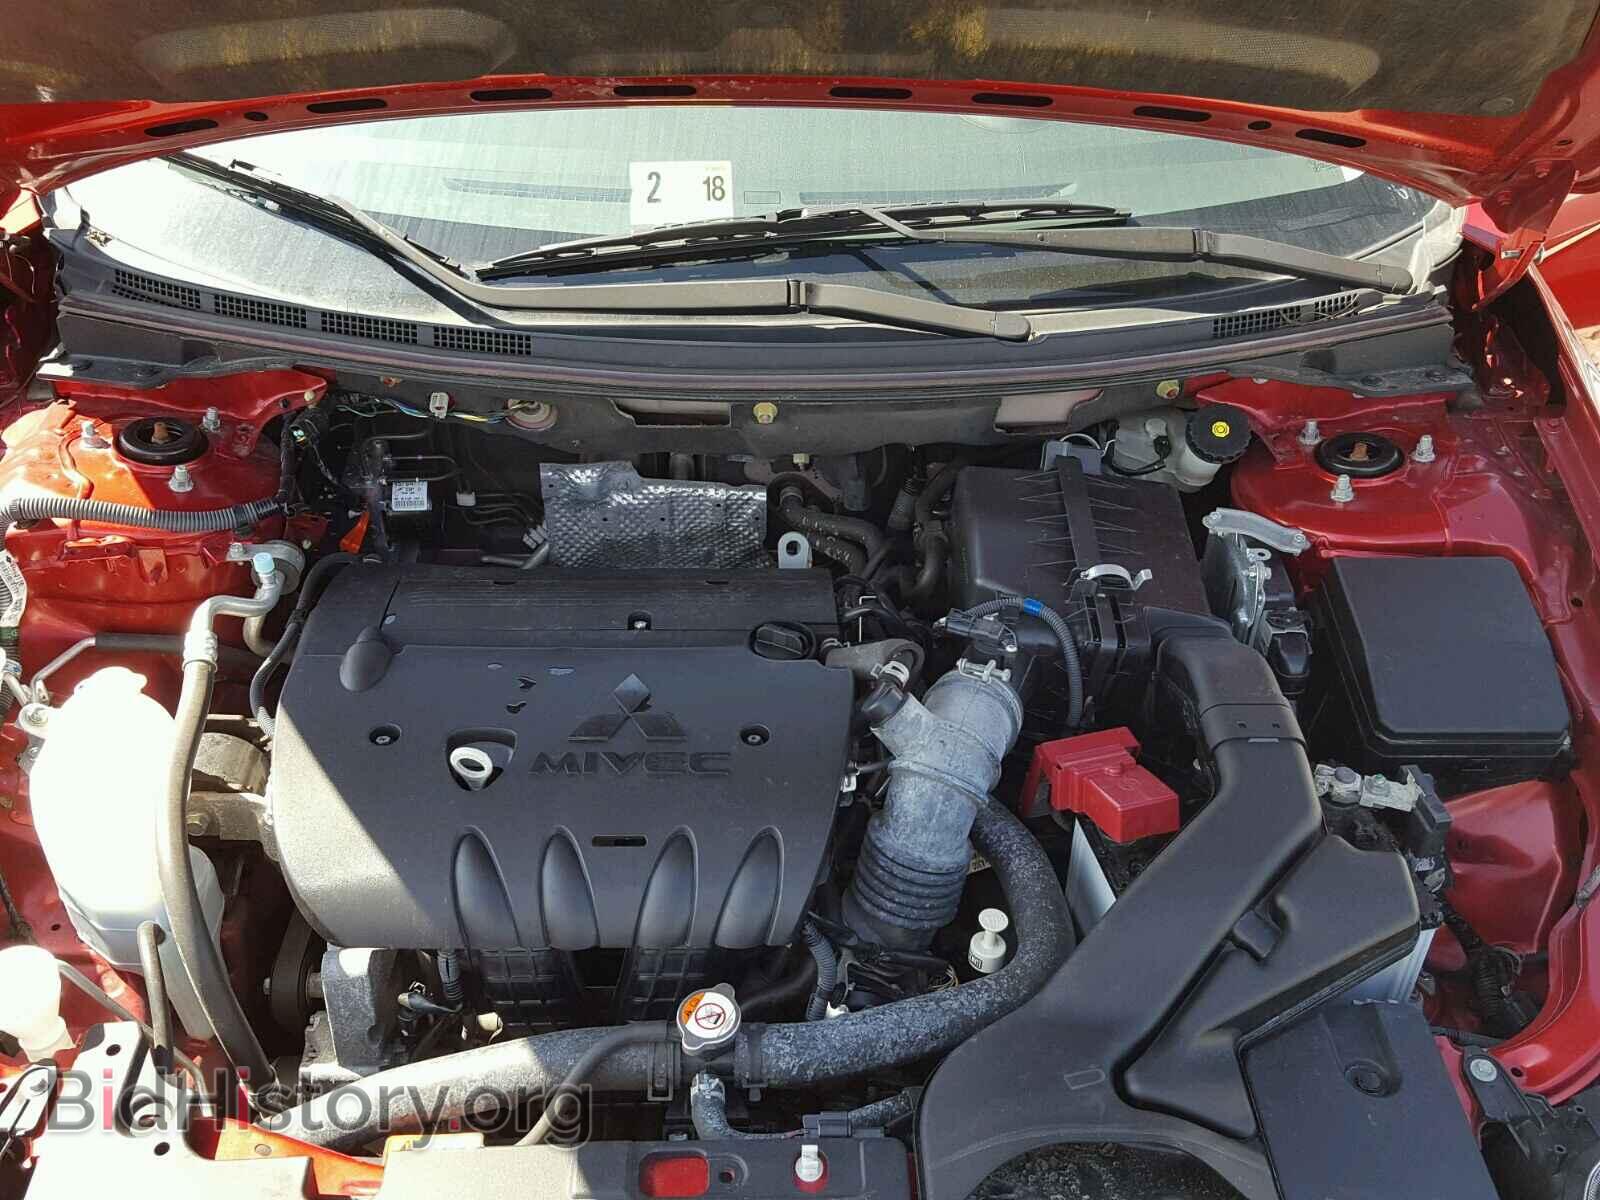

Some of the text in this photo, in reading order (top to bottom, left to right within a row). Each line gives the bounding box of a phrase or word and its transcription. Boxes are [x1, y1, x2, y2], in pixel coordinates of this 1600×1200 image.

[647, 171, 725, 203] 2 18
[528, 751, 732, 776] MIVEC
